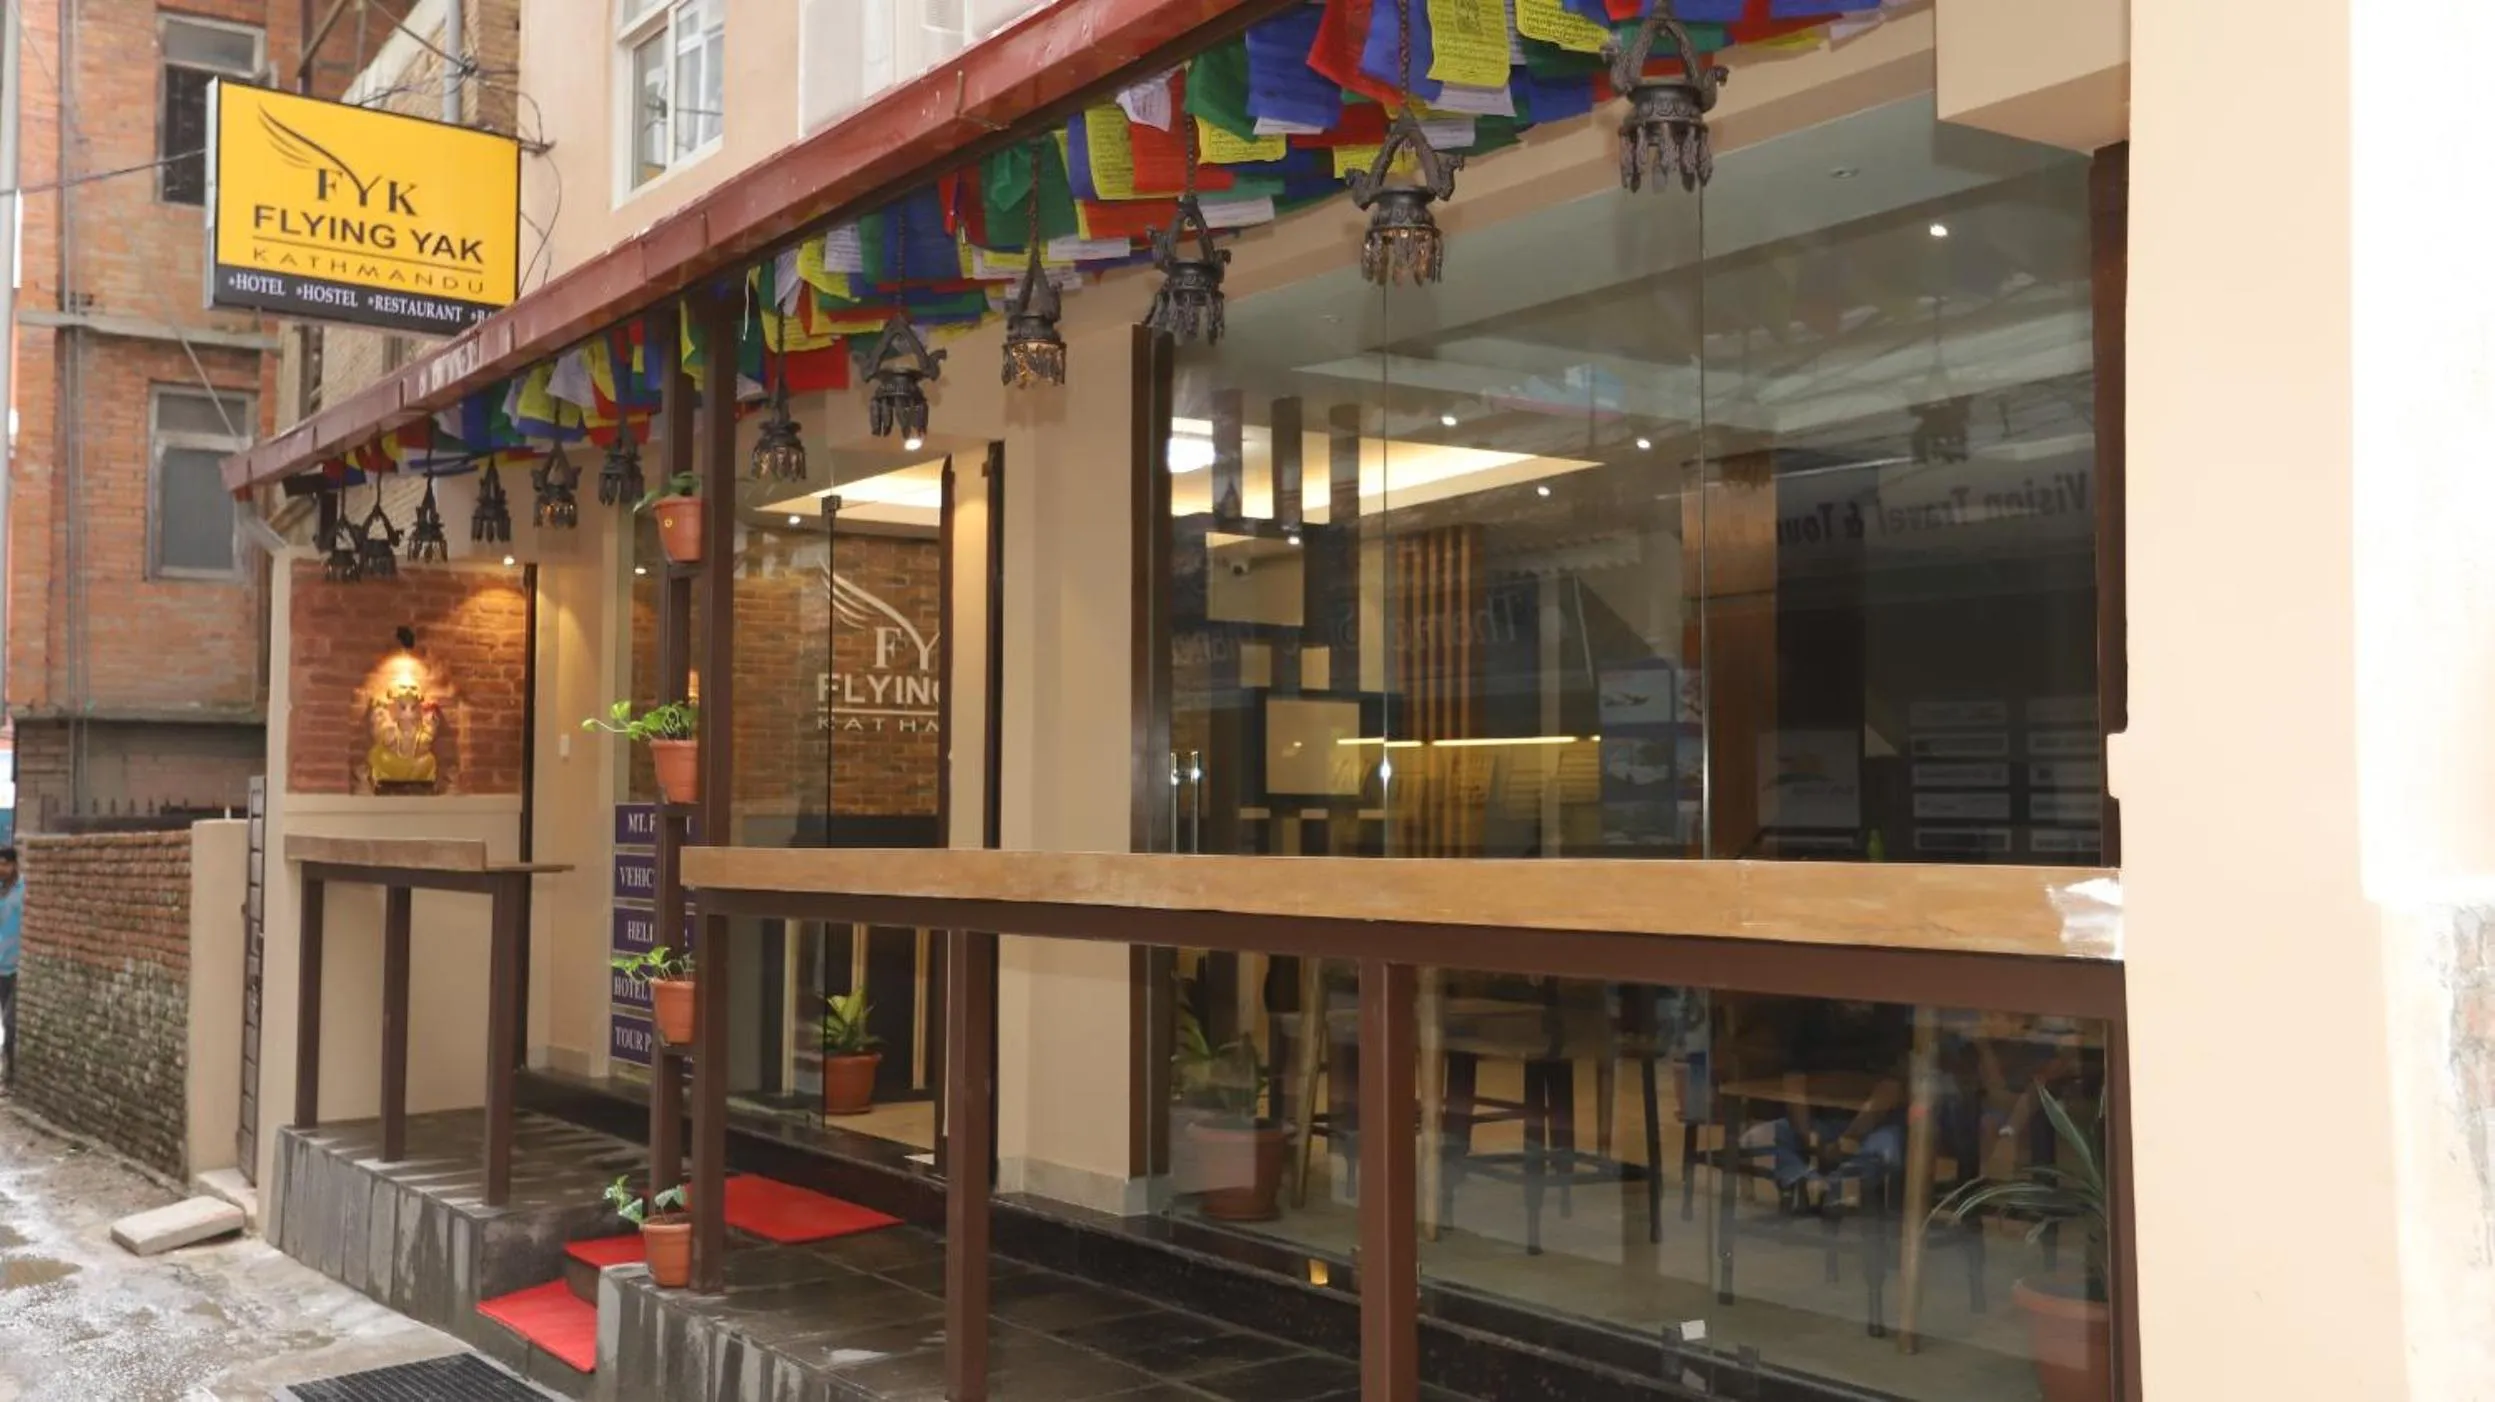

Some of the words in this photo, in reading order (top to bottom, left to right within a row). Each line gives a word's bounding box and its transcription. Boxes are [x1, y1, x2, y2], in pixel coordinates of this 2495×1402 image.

[254, 204, 396, 249] FLYING
[410, 229, 484, 264] YAK
[252, 246, 485, 295] KATHMANDU
[234, 272, 286, 296] HOTEL
[303, 284, 359, 307] HOSTEL
[375, 294, 463, 322] RESTAURANT
[619, 865, 655, 889] VEHIC
